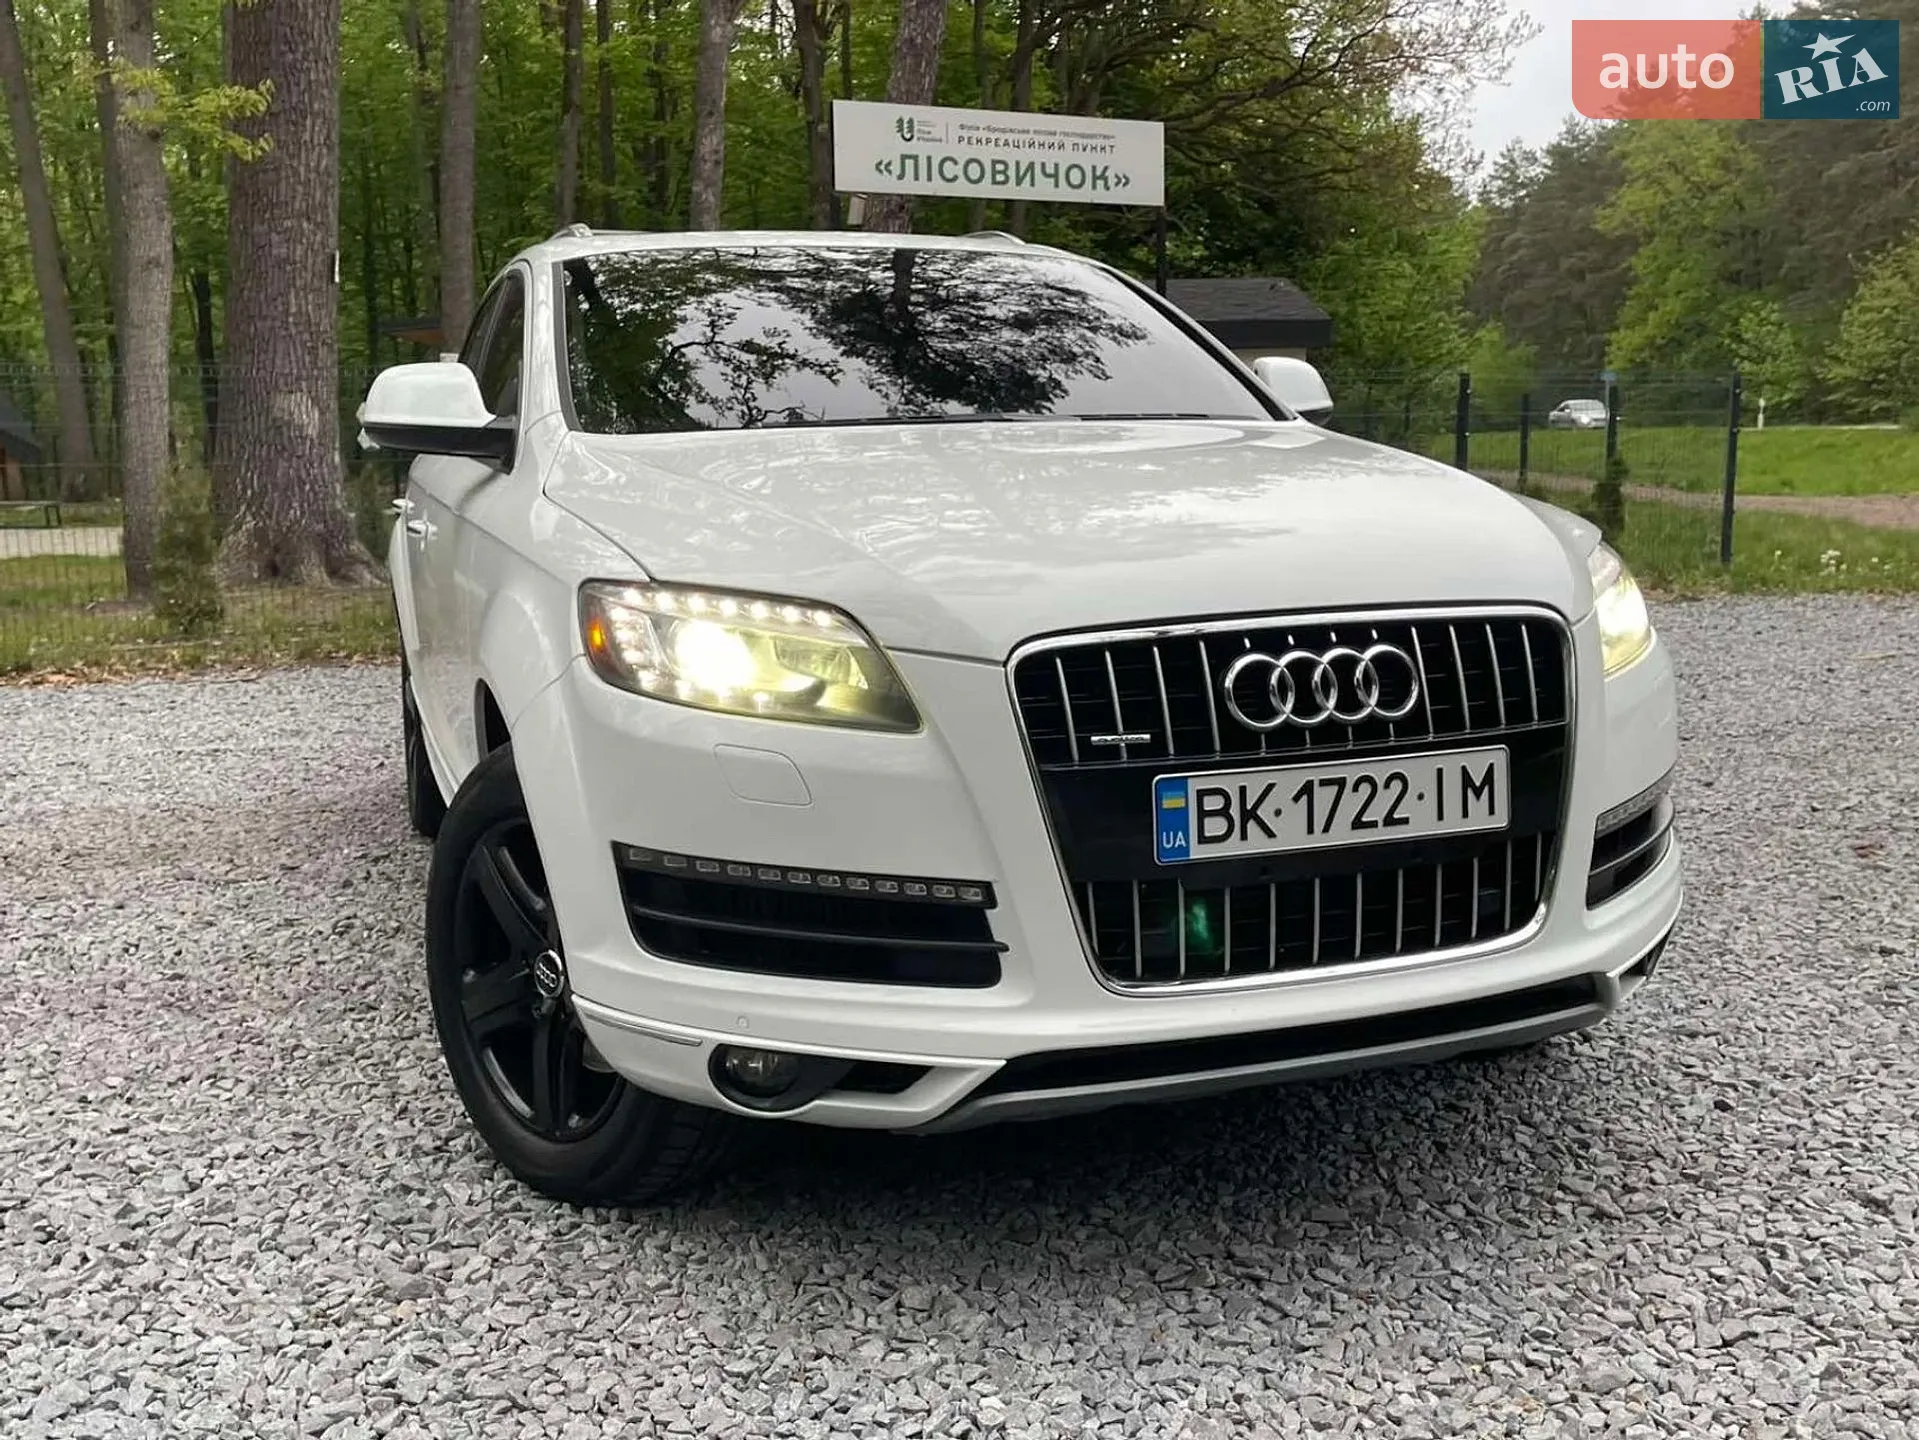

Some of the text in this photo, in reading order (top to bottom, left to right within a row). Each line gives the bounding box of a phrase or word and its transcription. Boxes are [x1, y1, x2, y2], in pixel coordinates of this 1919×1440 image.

[958, 136, 1065, 152] РЕКРЕАЦІЙНИЙ
[1072, 143, 1115, 155] ПУНКТ
[875, 154, 1130, 191] «ЛІСОВИЧОК»
[1163, 831, 1186, 848] UA
